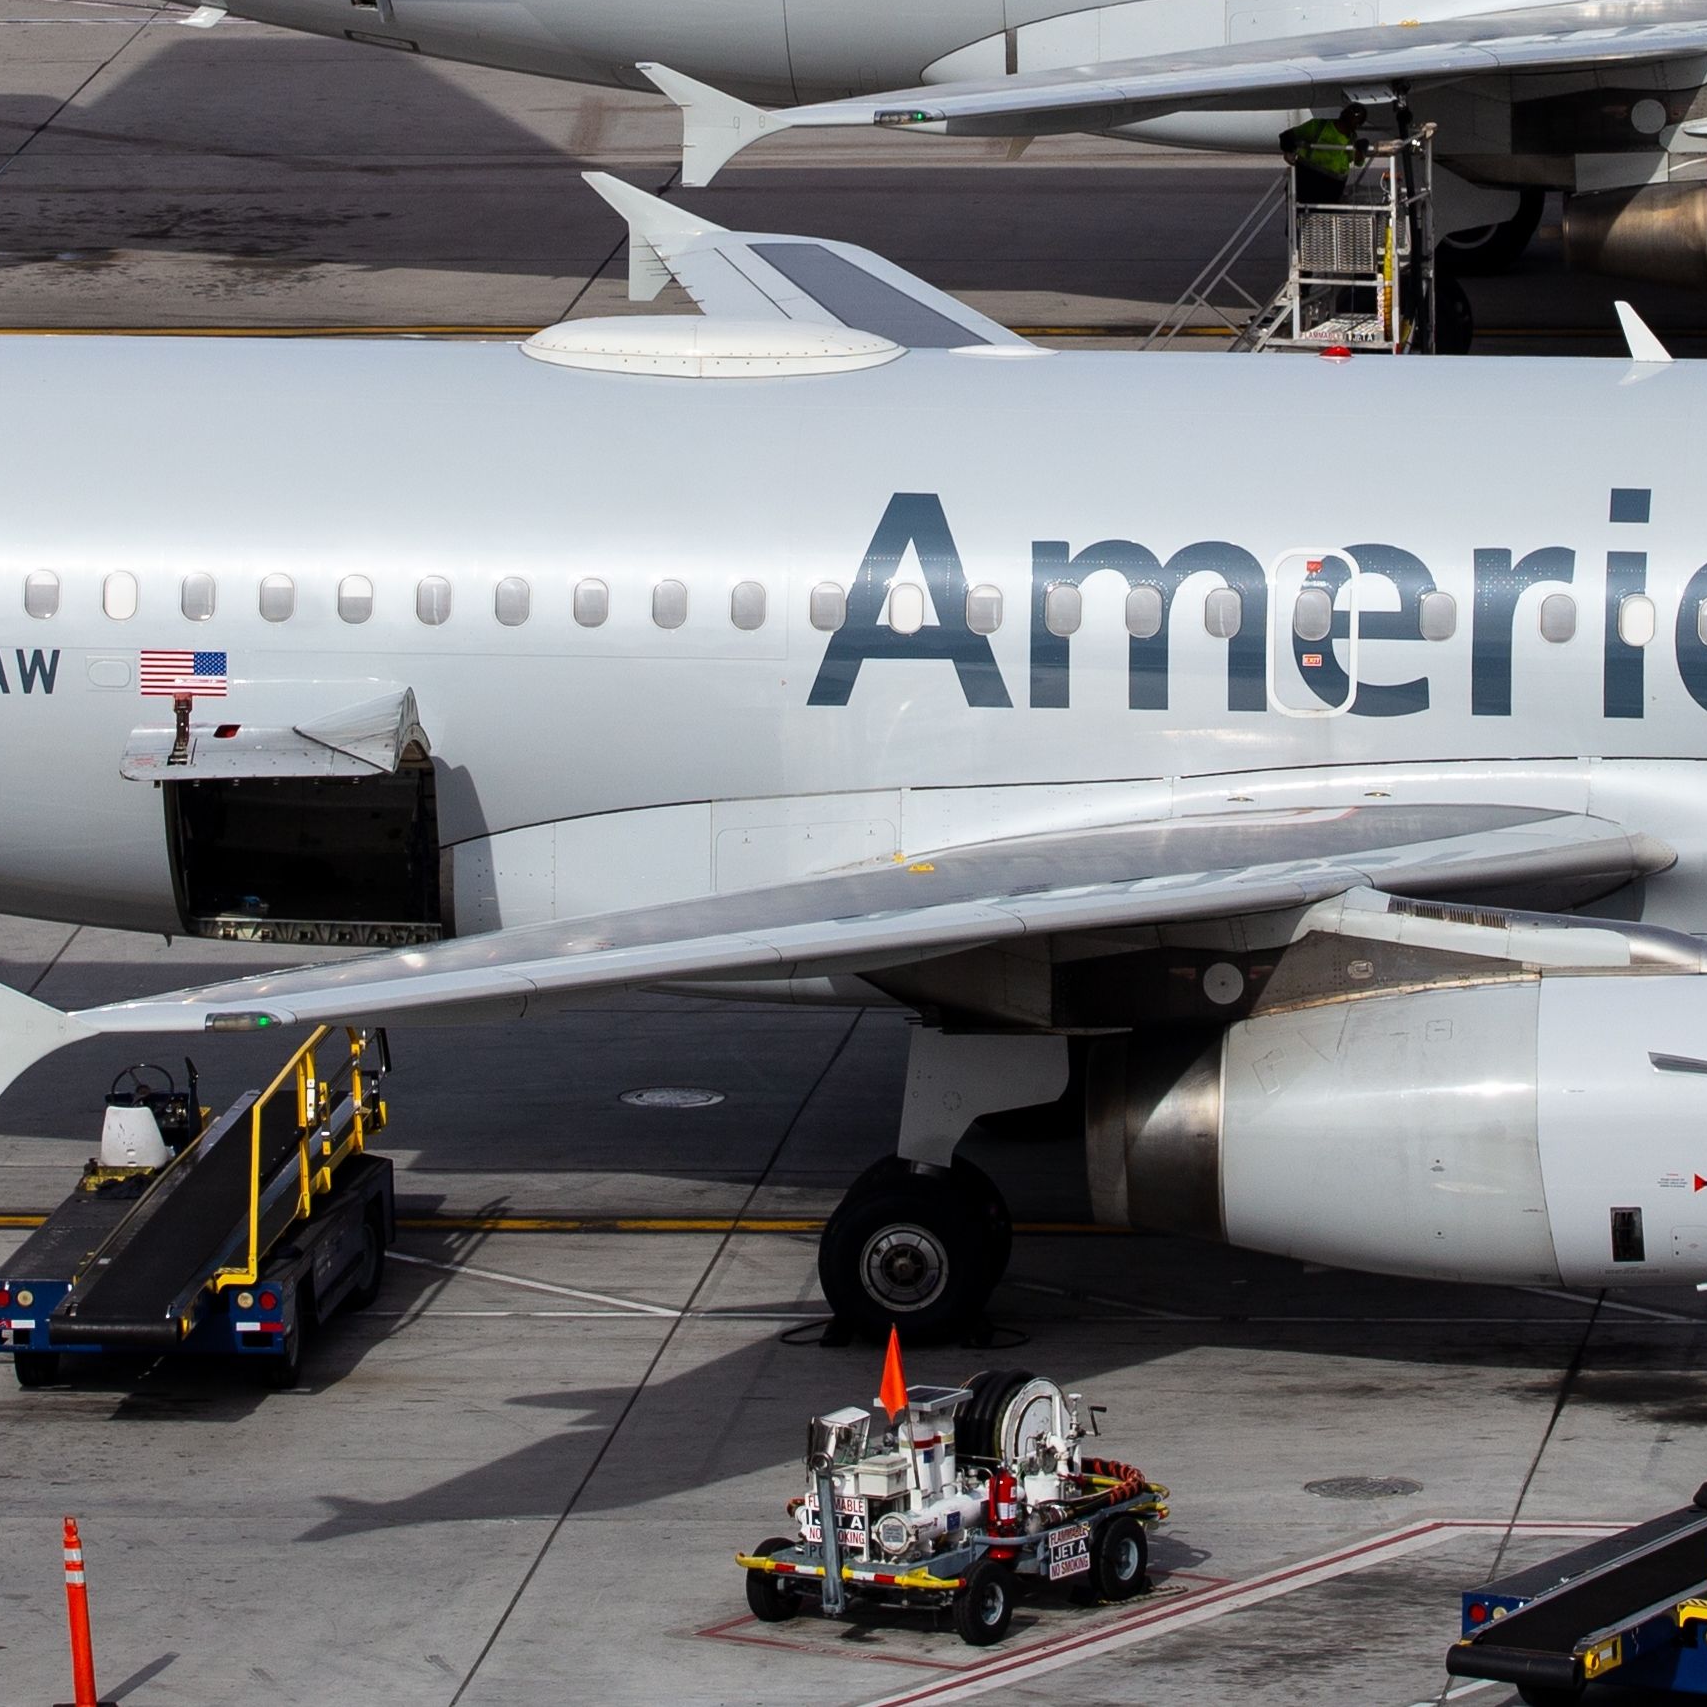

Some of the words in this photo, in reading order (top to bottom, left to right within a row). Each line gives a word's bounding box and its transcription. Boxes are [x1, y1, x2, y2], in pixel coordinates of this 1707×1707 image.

[808, 1494, 864, 1514] FLMABLE
[850, 1515, 863, 1530] A
[836, 1529, 865, 1544] OKING
[1055, 1542, 1075, 1561] JET
[1078, 1539, 1087, 1554] A
